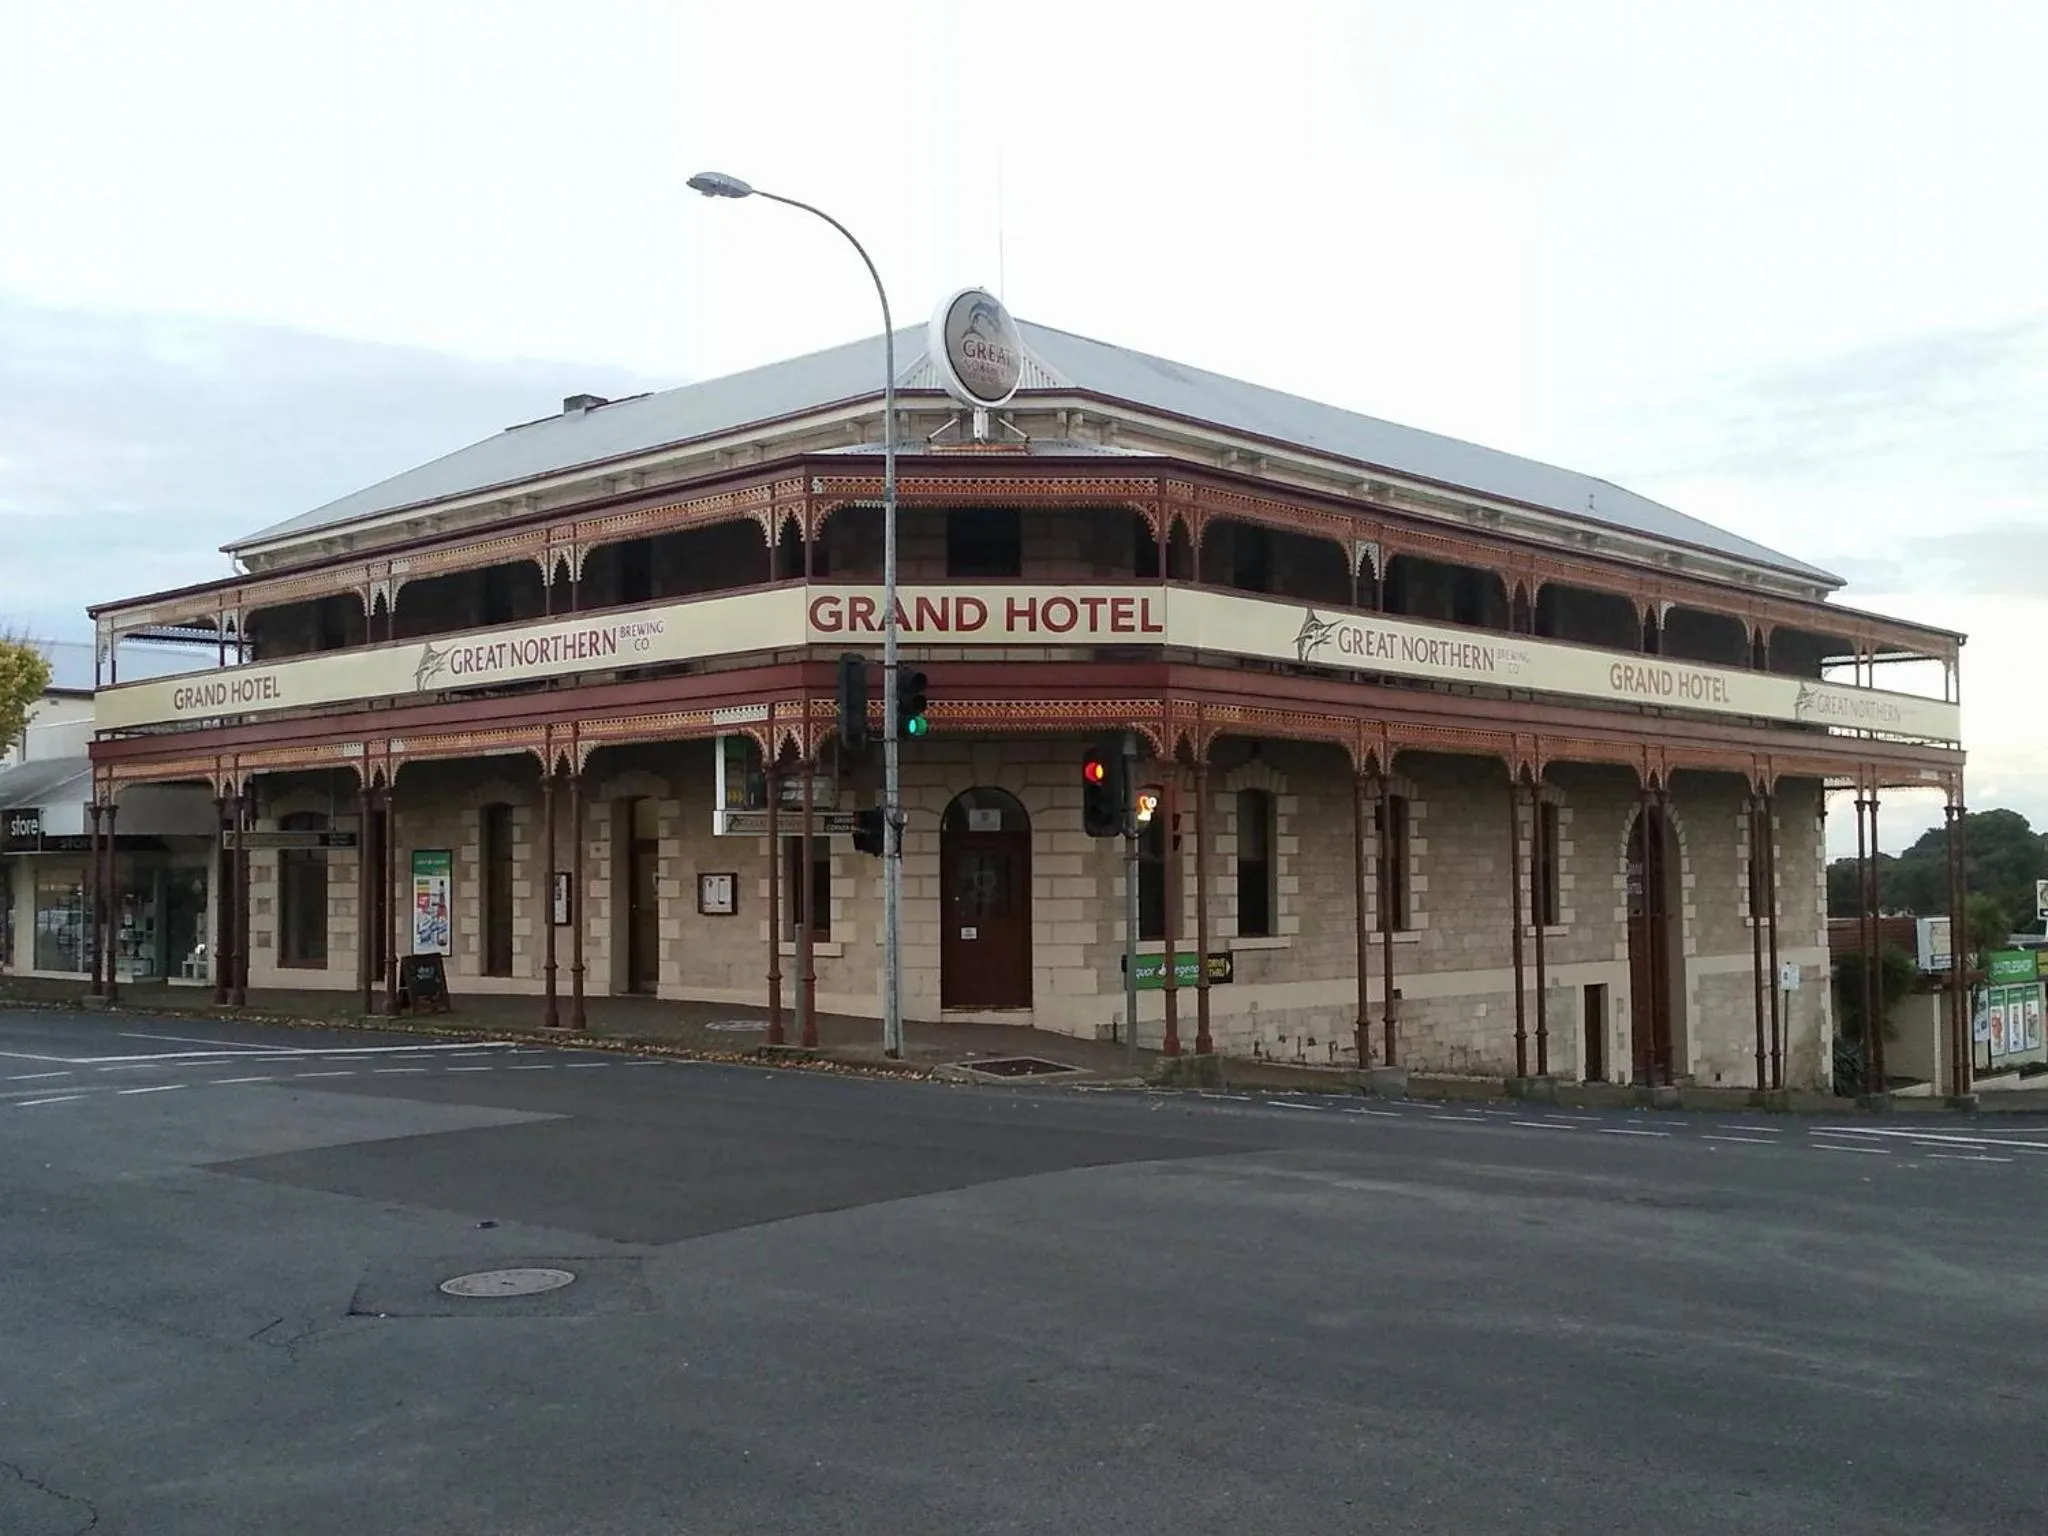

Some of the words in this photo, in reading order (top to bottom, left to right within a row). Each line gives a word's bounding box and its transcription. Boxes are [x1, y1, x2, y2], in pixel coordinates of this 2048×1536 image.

[963, 339, 1011, 366] GREAT
[619, 619, 665, 640] BREWING
[808, 596, 988, 633] GRAND
[1005, 596, 1164, 633] HOTEL
[450, 642, 507, 676] GREAT
[510, 627, 618, 667] NORTHERN
[1337, 626, 1398, 660] GREAT
[1401, 636, 1495, 672] NORTHERN
[173, 682, 227, 711] GRAND
[230, 675, 281, 703] HOTEL
[1609, 662, 1673, 696] GRAND
[1678, 672, 1731, 703] HOTEL
[1817, 693, 1848, 717] GREAT
[10, 814, 39, 836] store
